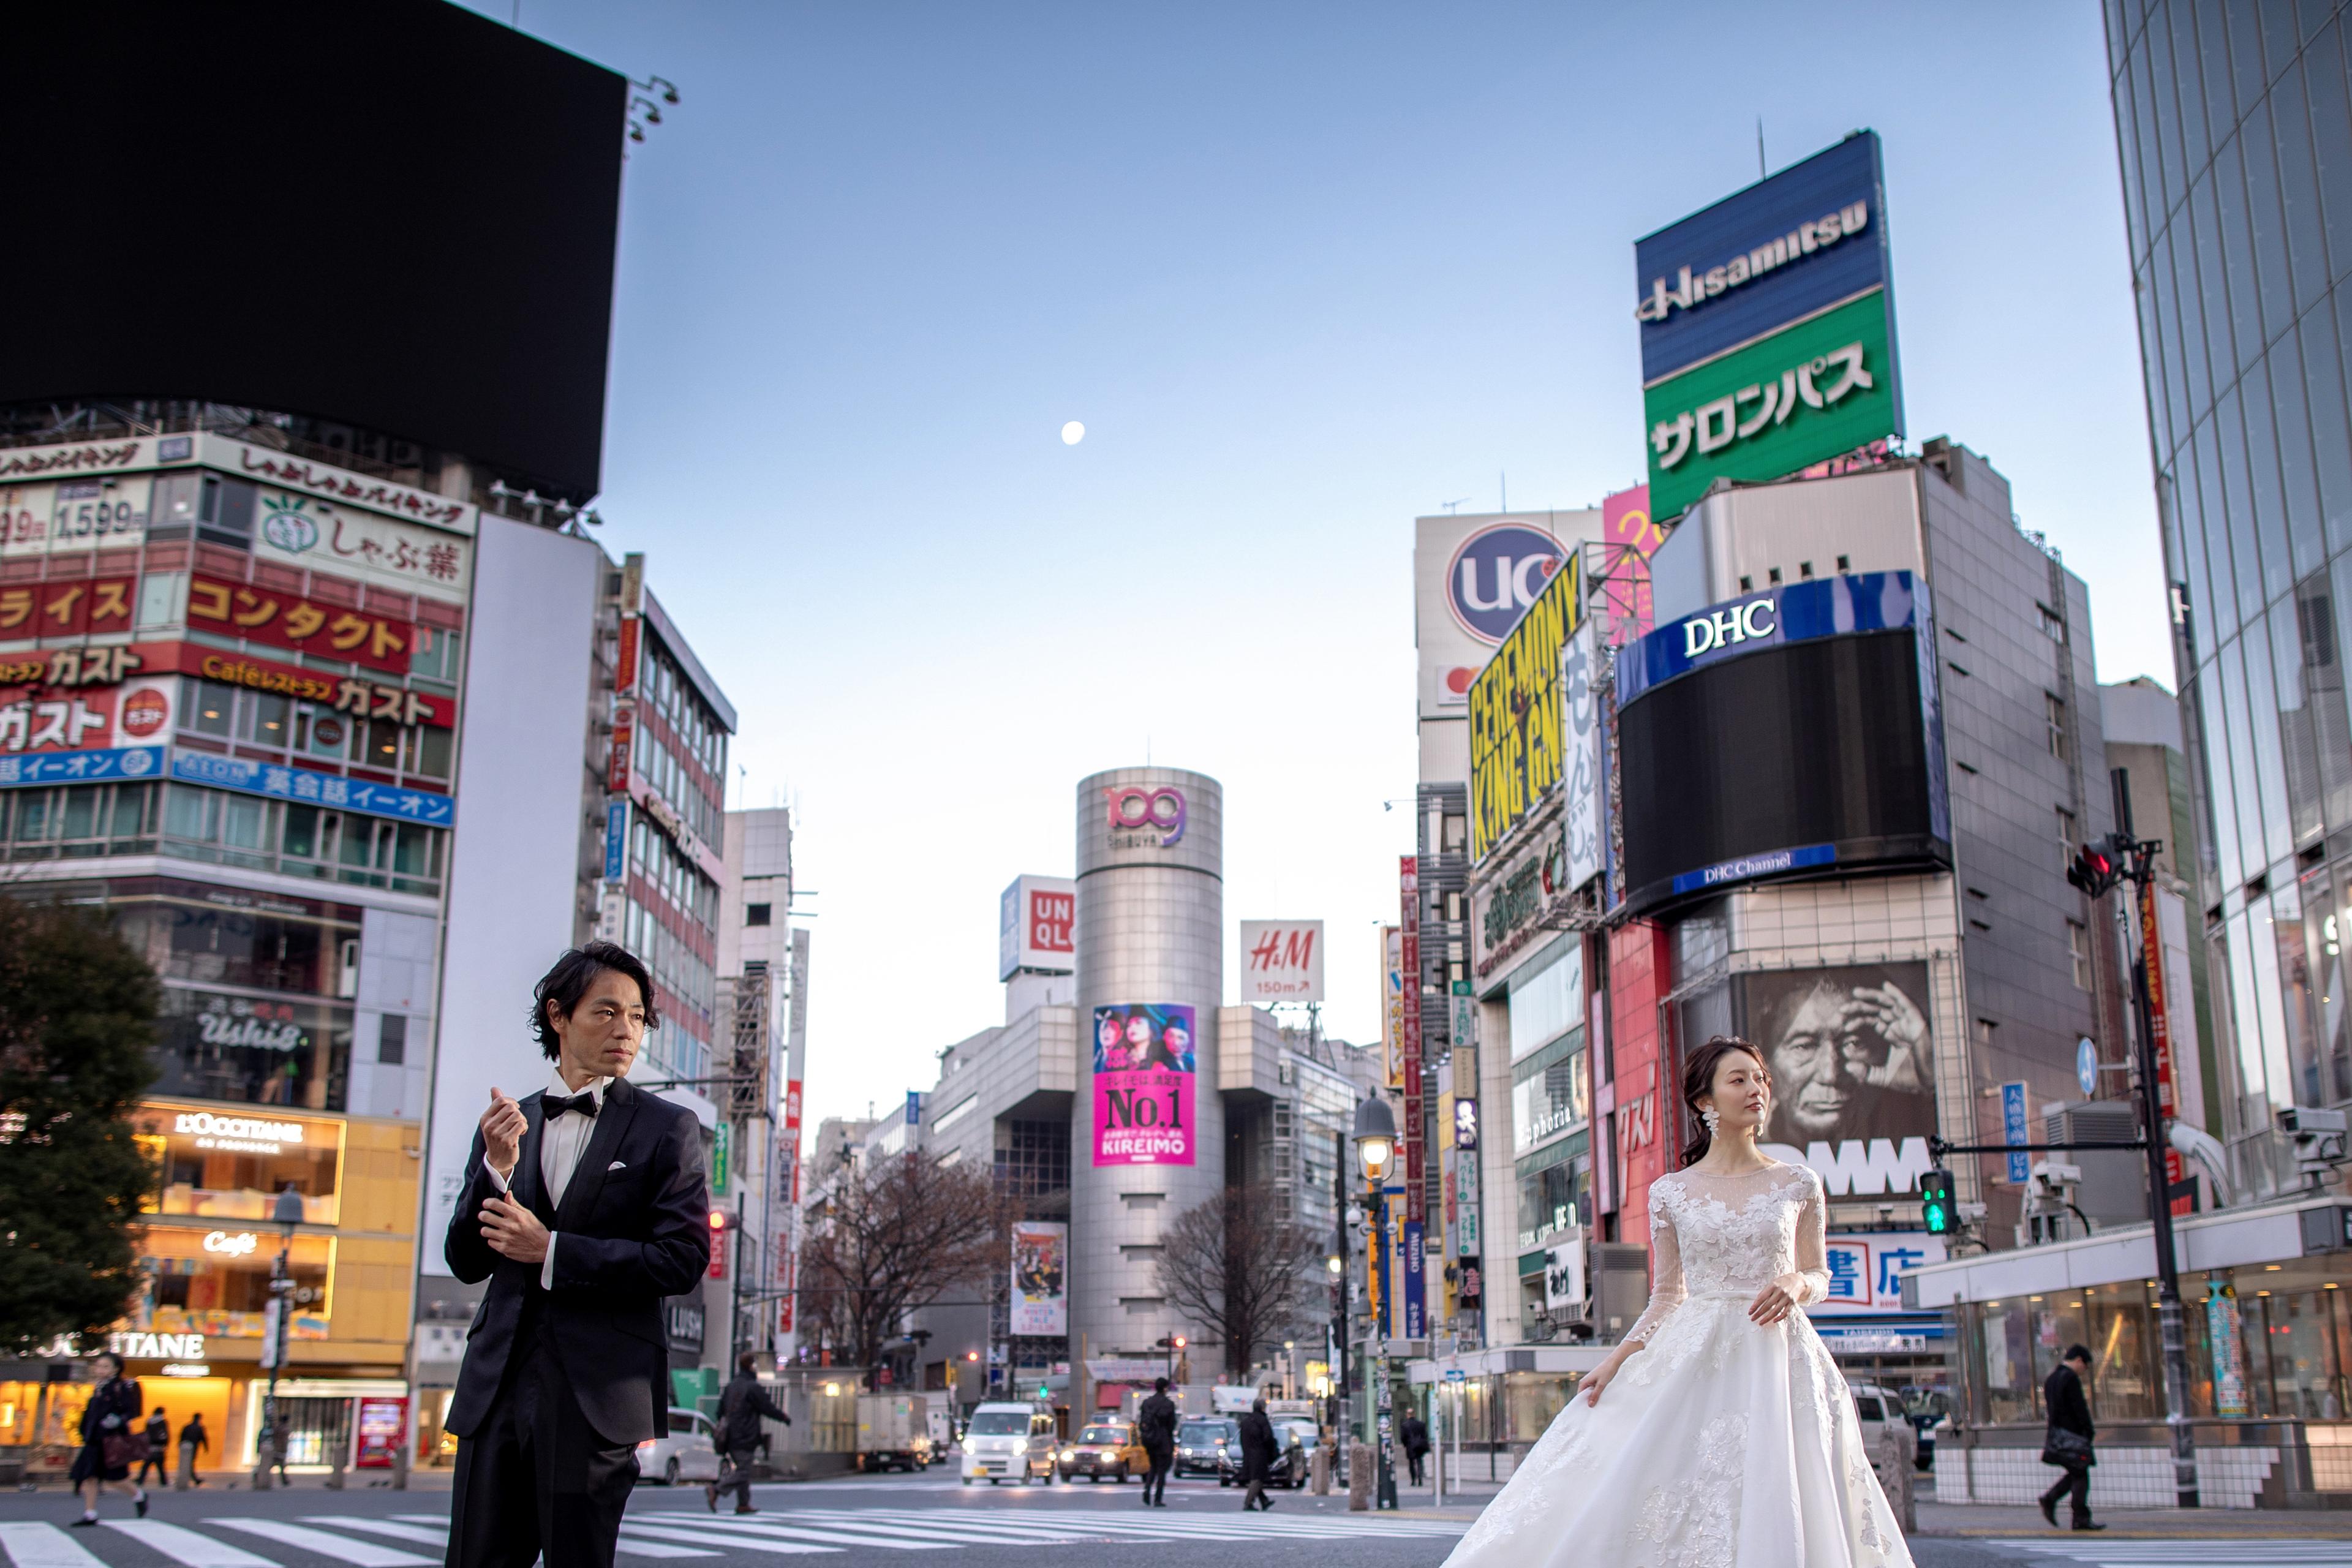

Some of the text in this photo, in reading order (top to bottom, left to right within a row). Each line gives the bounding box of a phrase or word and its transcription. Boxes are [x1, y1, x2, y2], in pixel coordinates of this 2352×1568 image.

[1635, 199, 1868, 322] Hisamitsu
[1650, 340, 1873, 470] サロンパス
[189, 580, 405, 658] コンタクト
[1684, 597, 1776, 658] DHC
[47, 646, 140, 685] ガスト
[1471, 554, 1579, 770] CEREMONY
[0, 699, 105, 752] ガスト
[334, 679, 435, 726] ガスト
[1564, 635, 1600, 870] もんじゃ
[264, 766, 450, 819] 英会話イーオン
[1102, 786, 1186, 846] 109
[1472, 723, 1523, 861] KING
[1107, 834, 1156, 847] SHIBUYA
[1705, 852, 1791, 884] DHC Channel
[1036, 897, 1069, 922] UN
[1250, 929, 1314, 971] H&M
[1105, 1088, 1182, 1129] No.1
[1515, 1104, 1572, 1147] Euphoria
[1102, 1138, 1185, 1155] KIREIMO
[1410, 1232, 1420, 1273] MIZUHO
